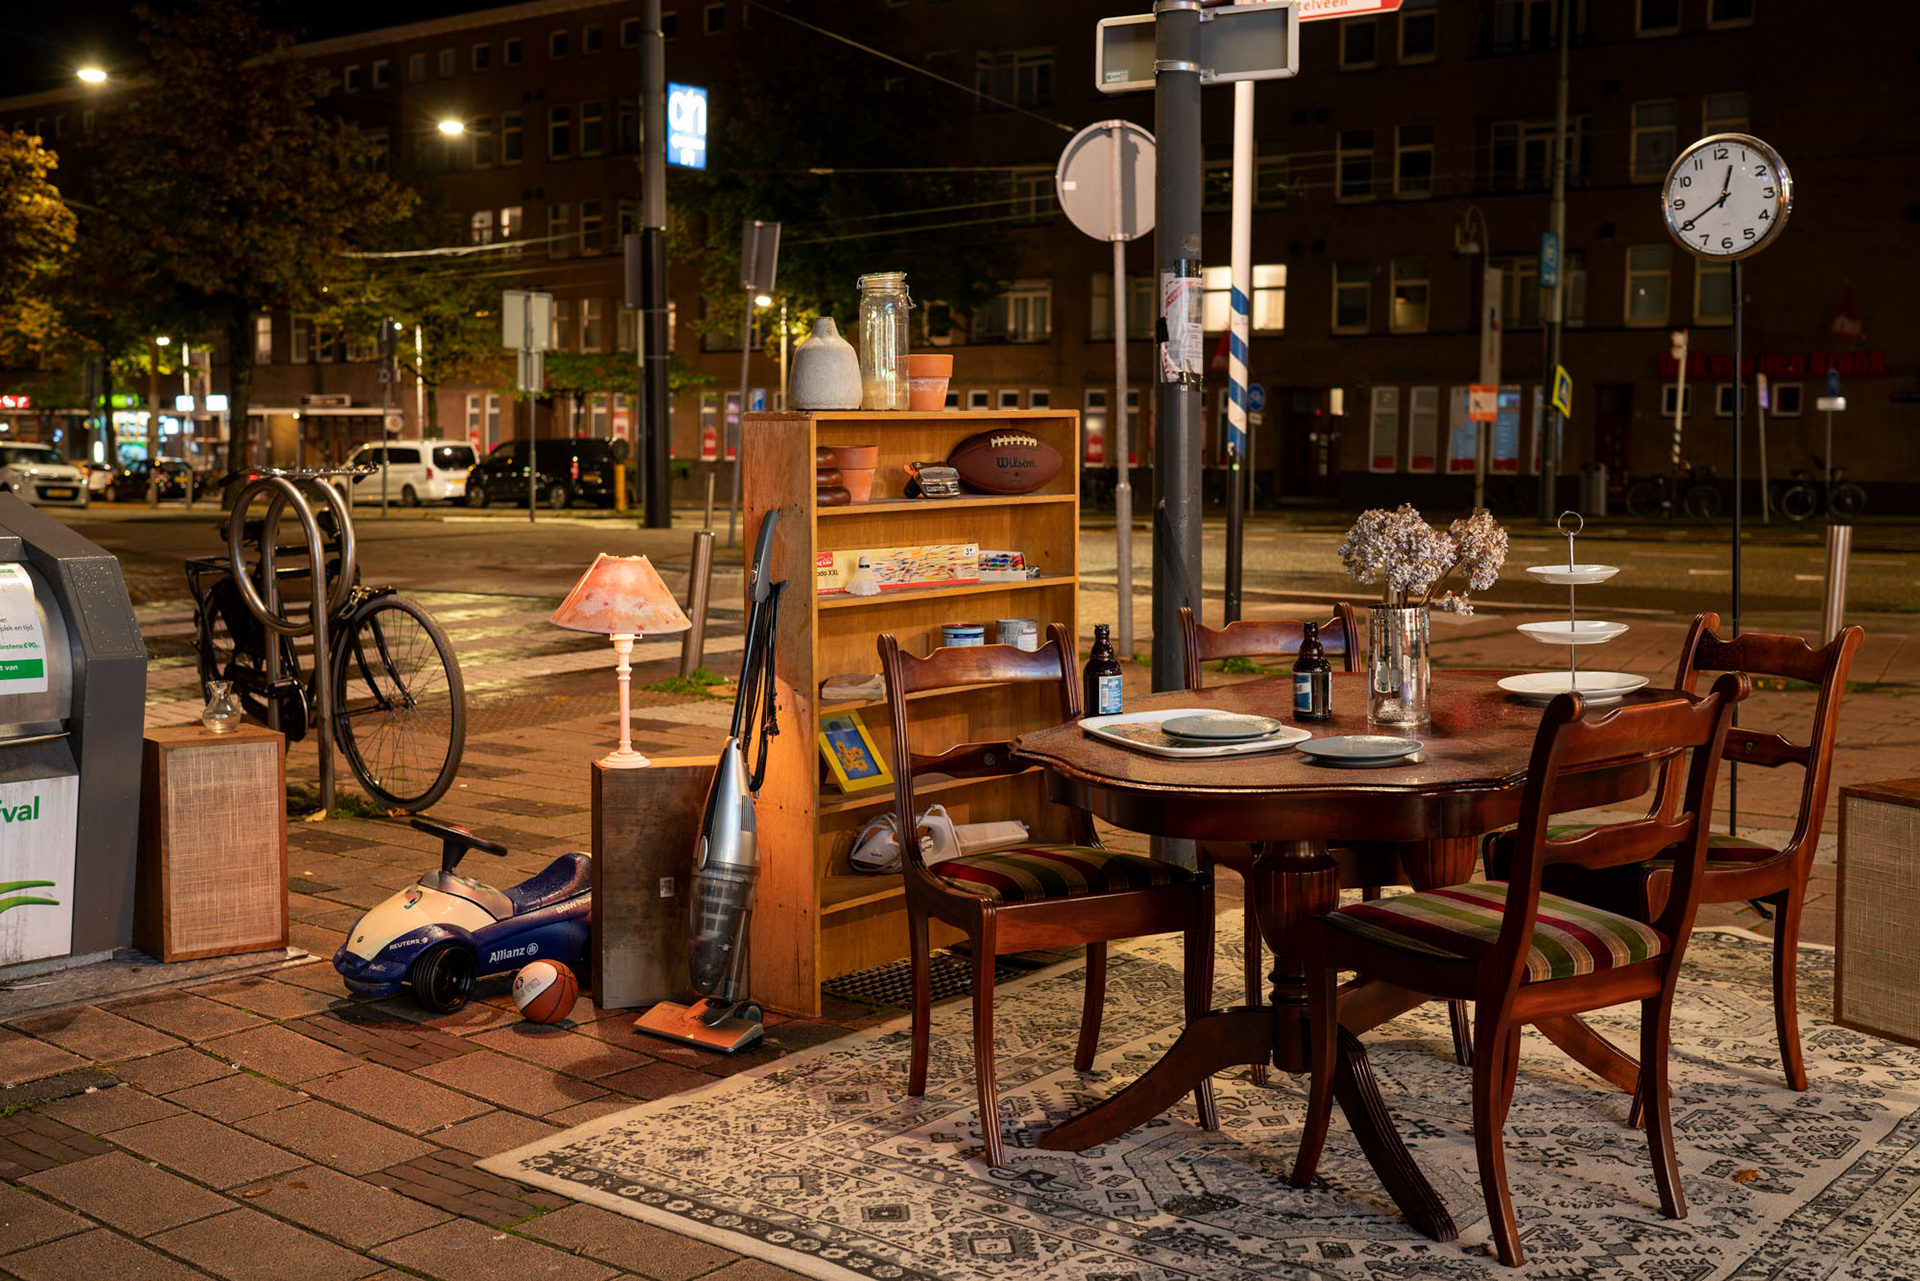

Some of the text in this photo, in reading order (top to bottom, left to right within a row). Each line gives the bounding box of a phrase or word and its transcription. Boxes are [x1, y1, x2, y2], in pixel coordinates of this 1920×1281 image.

[1298, 0, 1348, 11] elveen
[1713, 148, 1729, 160] 12
[1741, 150, 1746, 162] 1
[1694, 159, 1703, 171] 11
[1755, 165, 1767, 177] 2
[1680, 176, 1692, 188] 10
[1763, 187, 1776, 199] 3
[1673, 199, 1686, 210] 9
[1758, 209, 1770, 220] 4
[1682, 220, 1696, 231] 8
[1700, 234, 1710, 246] 7
[1743, 228, 1756, 240] 5
[1721, 237, 1734, 249] 6
[995, 456, 1035, 468] Wilson
[0, 795, 40, 823] val
[556, 900, 577, 914] BMW
[389, 938, 420, 950] REUTERS
[488, 946, 526, 964] Allianz
